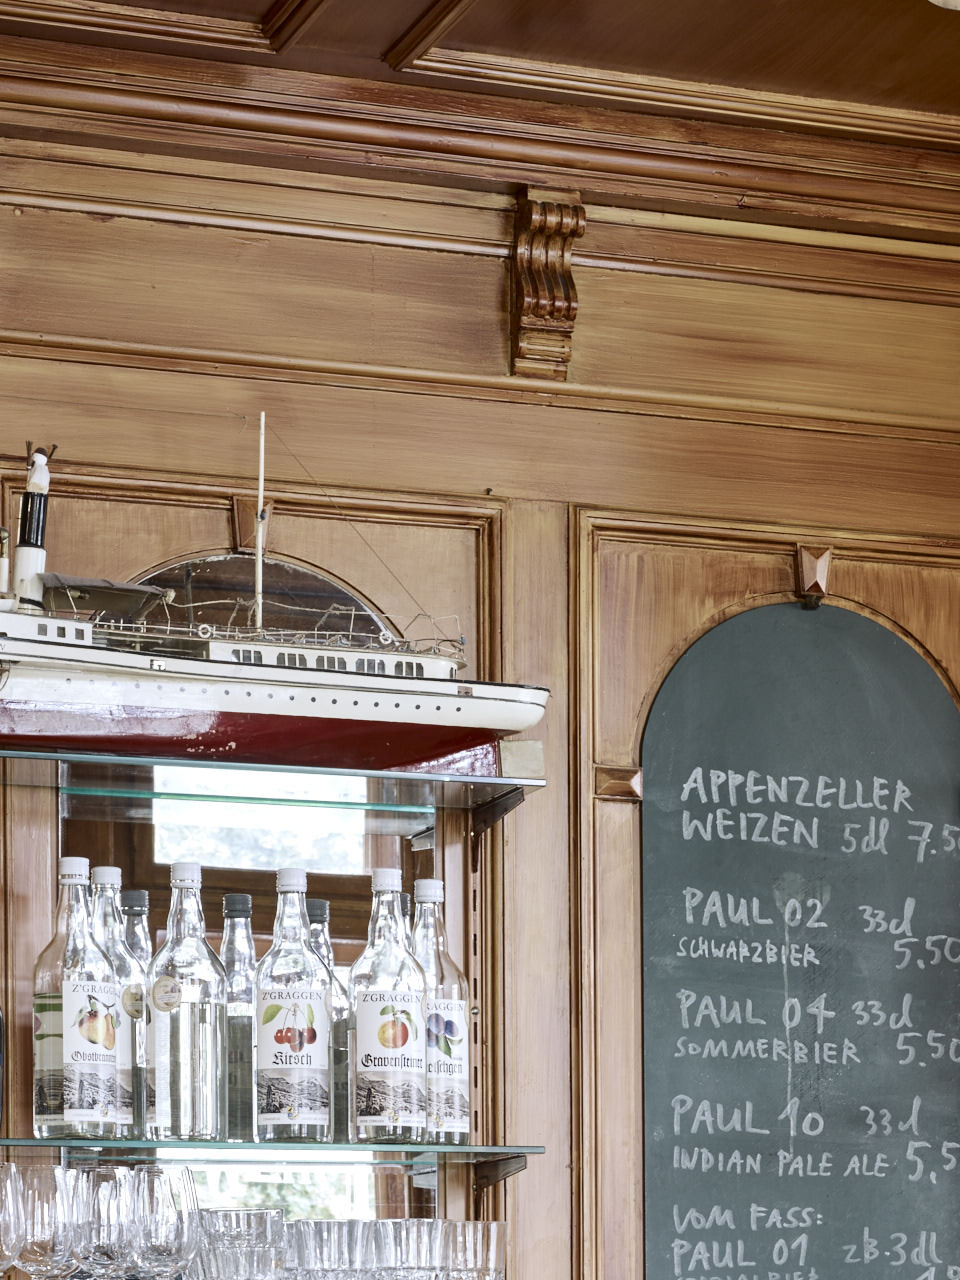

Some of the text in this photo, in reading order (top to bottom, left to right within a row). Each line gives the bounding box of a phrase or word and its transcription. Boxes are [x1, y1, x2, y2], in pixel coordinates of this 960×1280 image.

[680, 766, 914, 813] APPENZELLER
[682, 808, 819, 849] WEIZEN
[841, 815, 890, 855] 5dl
[682, 886, 773, 927] PAUL
[784, 898, 828, 928] 02
[676, 936, 820, 967] SCHWARZBIER
[676, 988, 766, 1029] PAUL
[782, 993, 836, 1034] 04
[271, 1051, 312, 1066] Kirsch
[674, 1035, 861, 1065] SOMMERBIER
[671, 1094, 770, 1136] PAUL
[777, 1096, 824, 1137] 10
[673, 1146, 762, 1174] INDIAN
[776, 1150, 833, 1177] PALE
[843, 1152, 888, 1177] ALE
[672, 1203, 824, 1233] VOM FASS:
[671, 1237, 756, 1277] PAUL
[772, 1233, 809, 1267] 01
